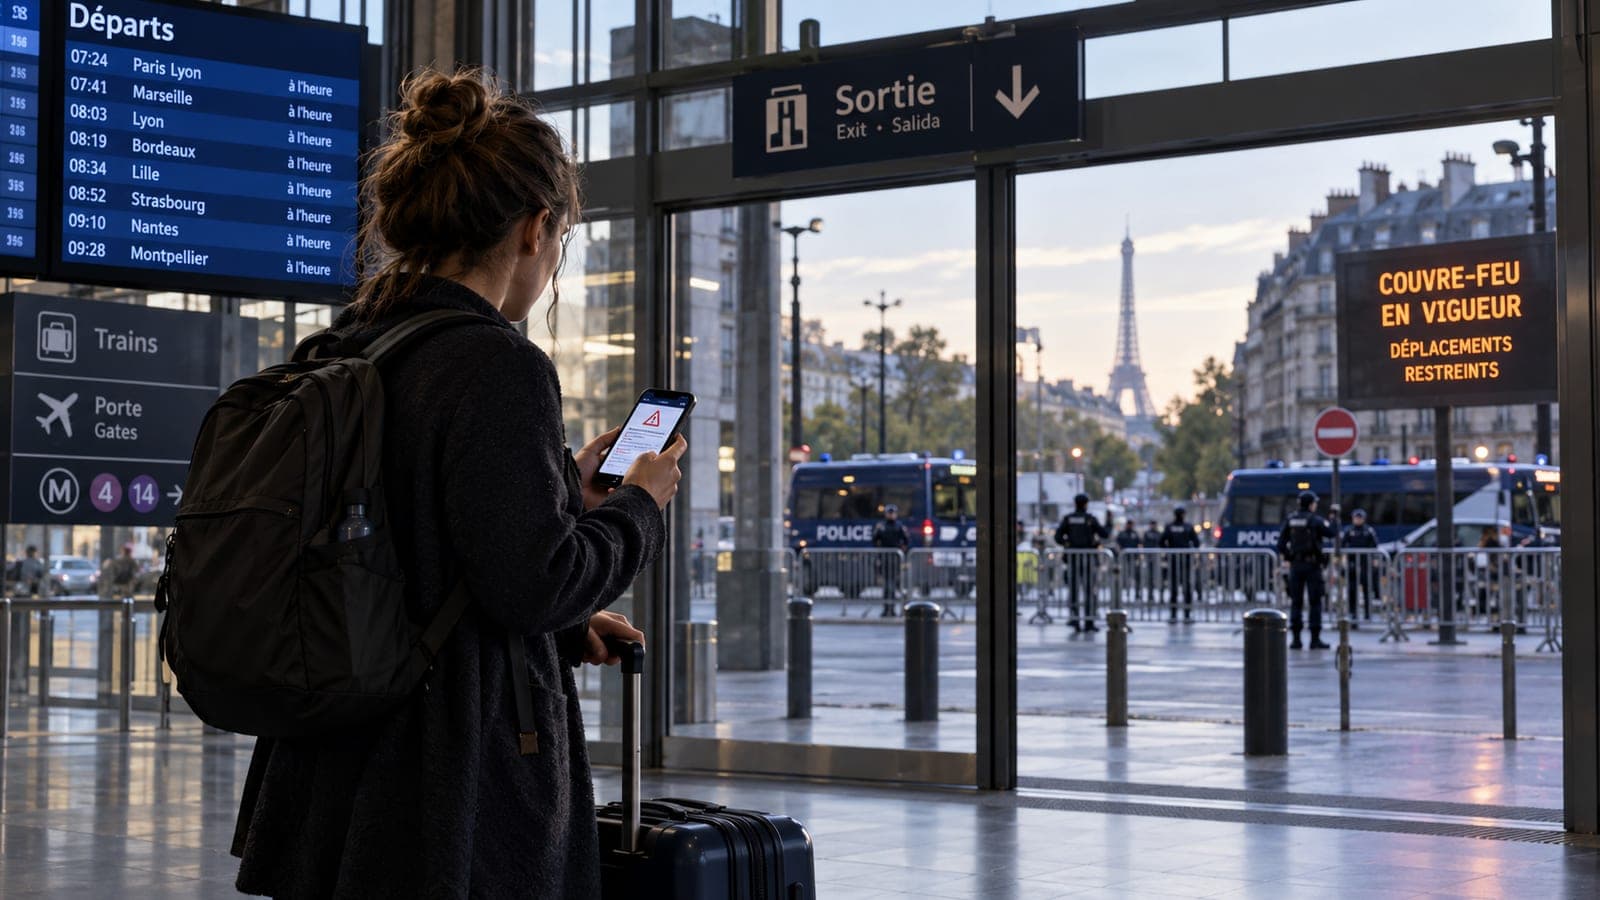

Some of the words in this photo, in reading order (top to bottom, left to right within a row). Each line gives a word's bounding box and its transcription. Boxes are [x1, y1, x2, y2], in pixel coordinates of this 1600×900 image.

[70, 2, 174, 41] Départs
[71, 49, 108, 67] 07:24
[133, 57, 166, 75] Paris
[171, 62, 202, 81] Lyon
[288, 79, 295, 92] à
[298, 80, 333, 97] l'heure
[70, 76, 107, 95] 07:41
[133, 84, 193, 106] Marseille
[288, 105, 295, 118] à
[298, 106, 332, 122] l'heure
[835, 74, 936, 116] Sortie
[70, 104, 107, 121] 08:03
[133, 112, 164, 129] Lyon
[288, 131, 295, 143] à
[298, 132, 332, 148] l'heure
[836, 121, 867, 140] Exit
[892, 112, 941, 134] Salida
[70, 131, 107, 149] 08:19
[132, 138, 196, 158] Bordeaux
[288, 156, 295, 169] à
[297, 157, 332, 173] l'heure
[69, 158, 107, 176] 08:34
[132, 165, 160, 181] Lille
[287, 182, 294, 195] à
[297, 183, 332, 199] l'heure
[69, 185, 106, 203] 08:52
[131, 191, 206, 215] Strasbourg
[287, 208, 294, 221] à
[297, 208, 331, 224] l'heure
[68, 213, 106, 230] 09:10
[131, 219, 179, 237] Nantes
[286, 234, 293, 247] à
[296, 234, 331, 250] l'heure
[68, 240, 106, 258] 09:28
[131, 246, 209, 266] Montpellier
[286, 260, 293, 273] à
[296, 260, 331, 276] l'heure
[1379, 260, 1520, 296] COUVRE-FEU
[1381, 303, 1411, 328] EN
[1422, 294, 1522, 324] VIGUEUR
[94, 327, 158, 354] Trains
[1390, 335, 1513, 359] DÉPLACEMENTS
[1405, 361, 1499, 382] RESTREINTS
[95, 396, 143, 418] Porte
[94, 422, 138, 441] Gates
[49, 478, 71, 504] M
[98, 481, 113, 504] 4
[133, 483, 154, 505] 14
[817, 524, 872, 541] POLICE
[1237, 530, 1281, 547] POLIC
